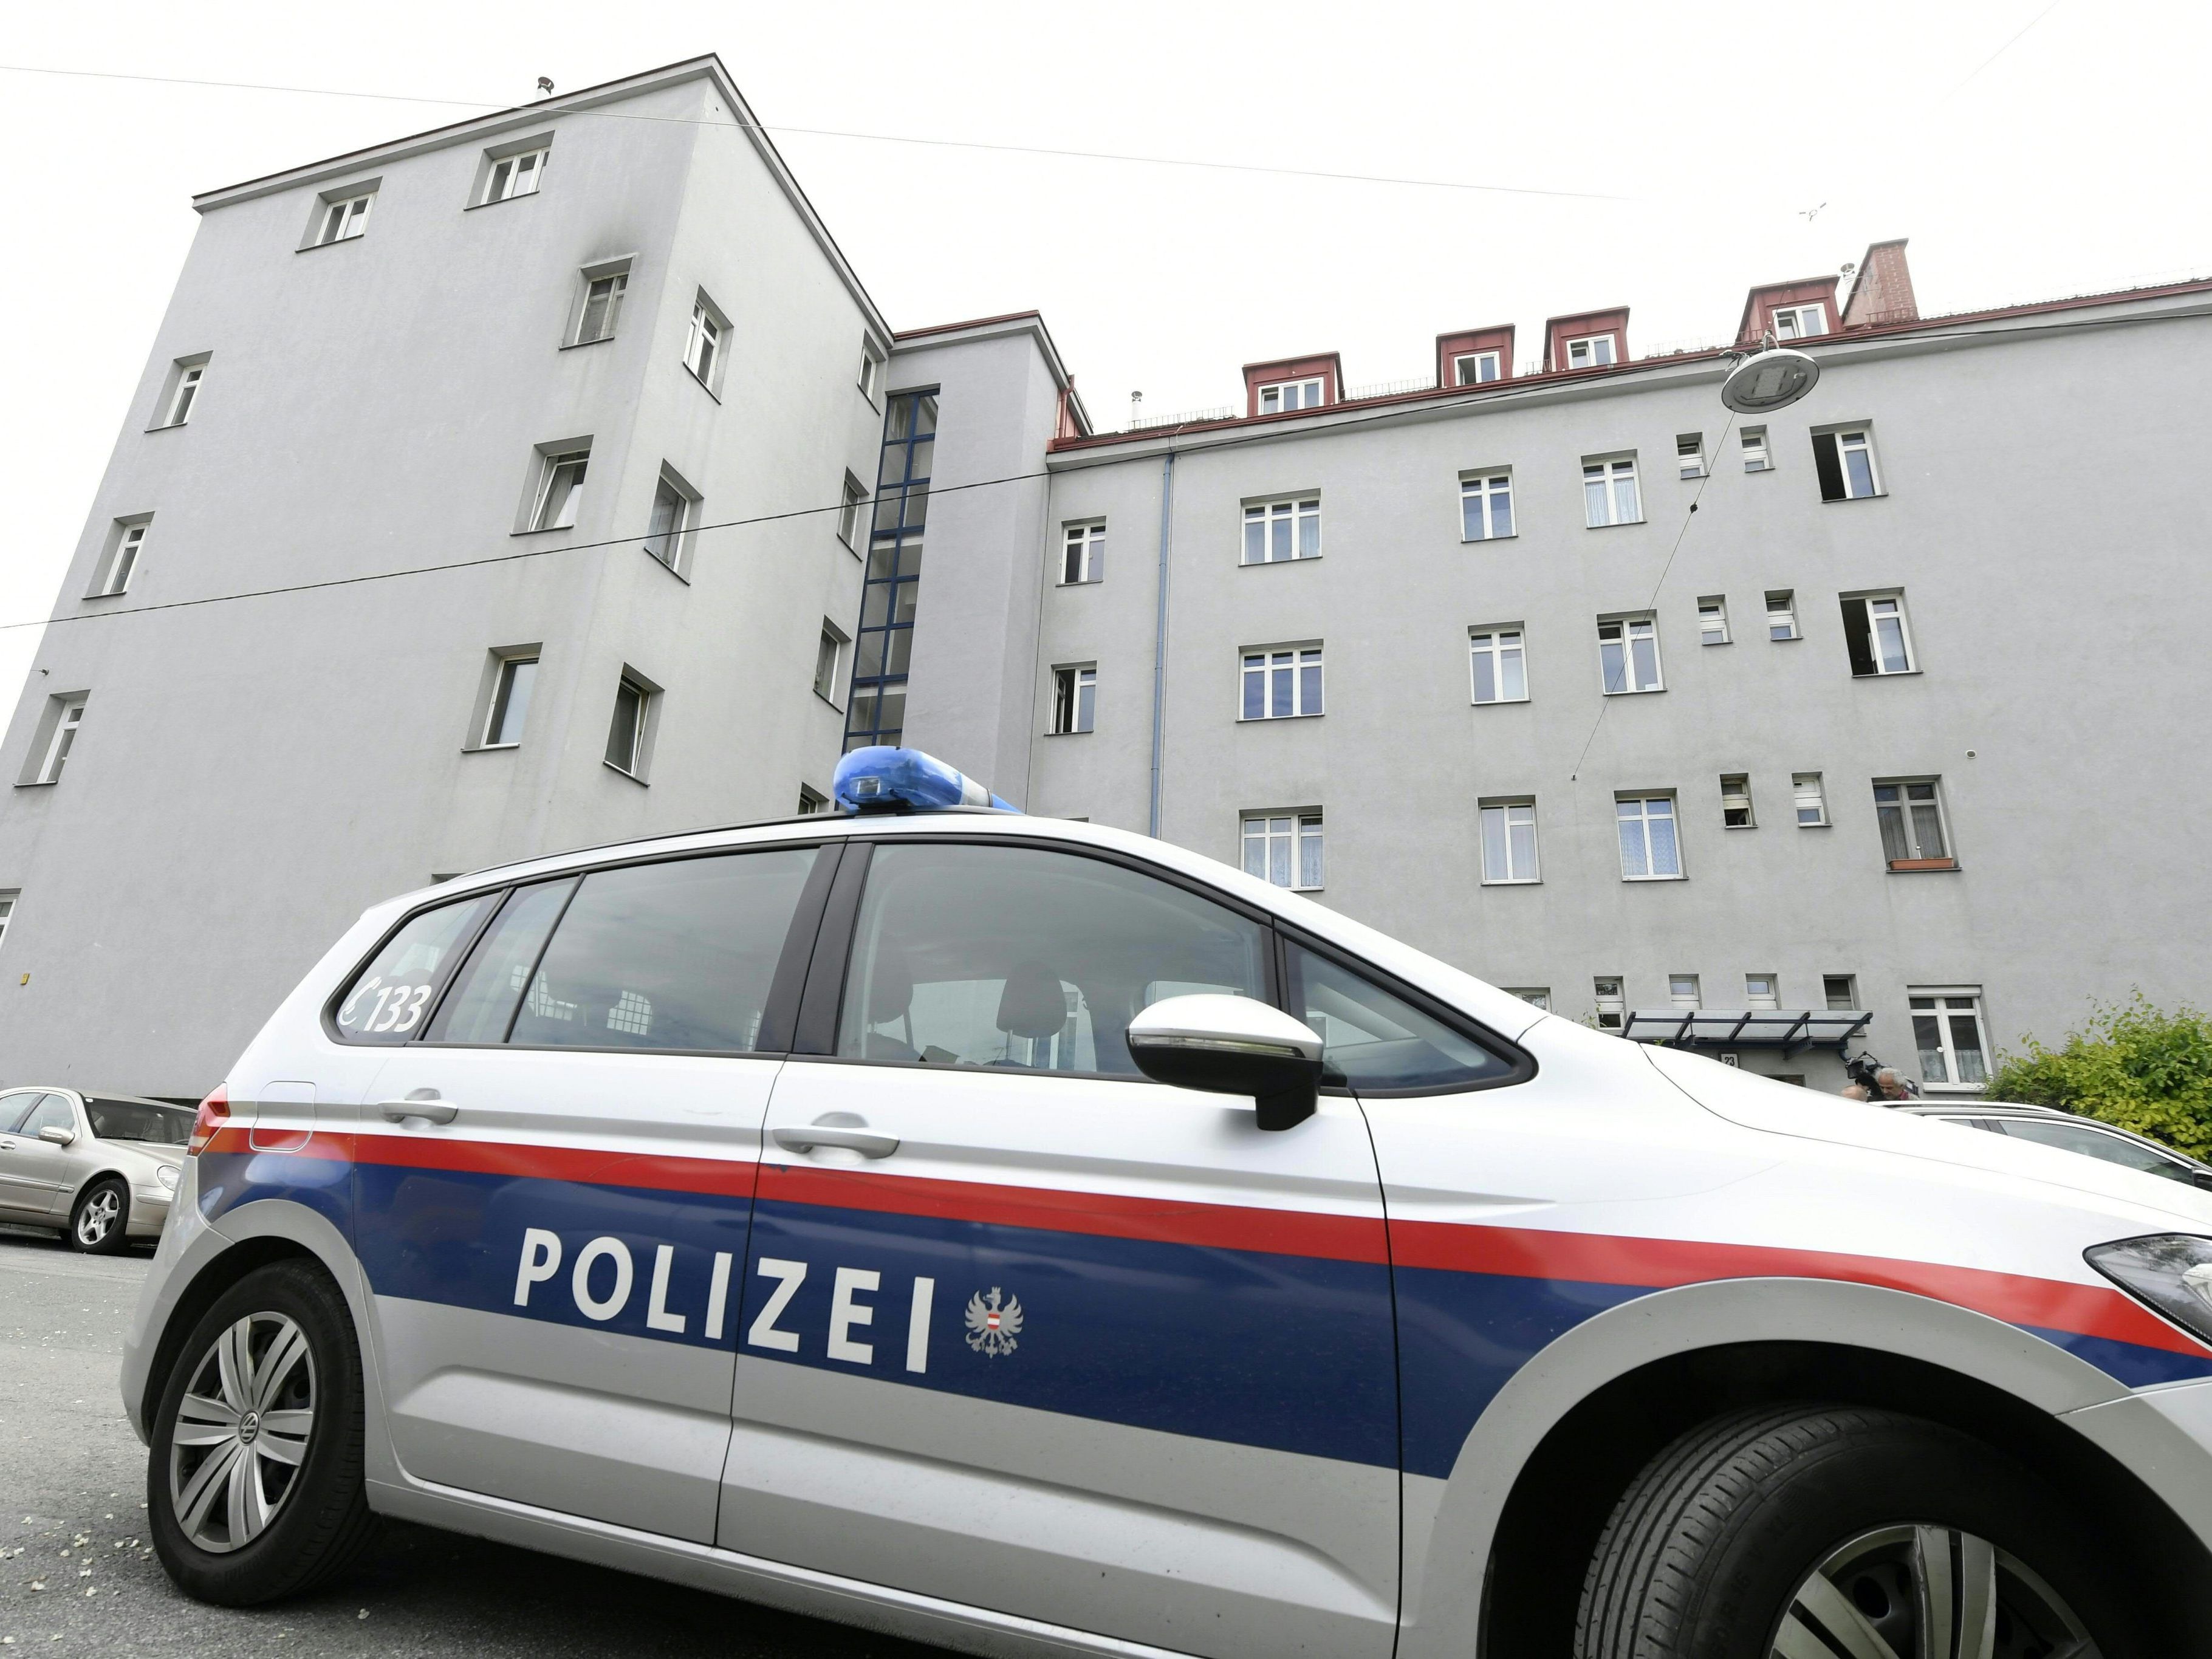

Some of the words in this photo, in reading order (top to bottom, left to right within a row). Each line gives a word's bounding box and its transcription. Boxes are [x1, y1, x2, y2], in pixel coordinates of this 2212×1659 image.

[363, 985, 432, 1032] 133
[1724, 1056, 1735, 1067] 23
[513, 1227, 935, 1373] POLIZEI
